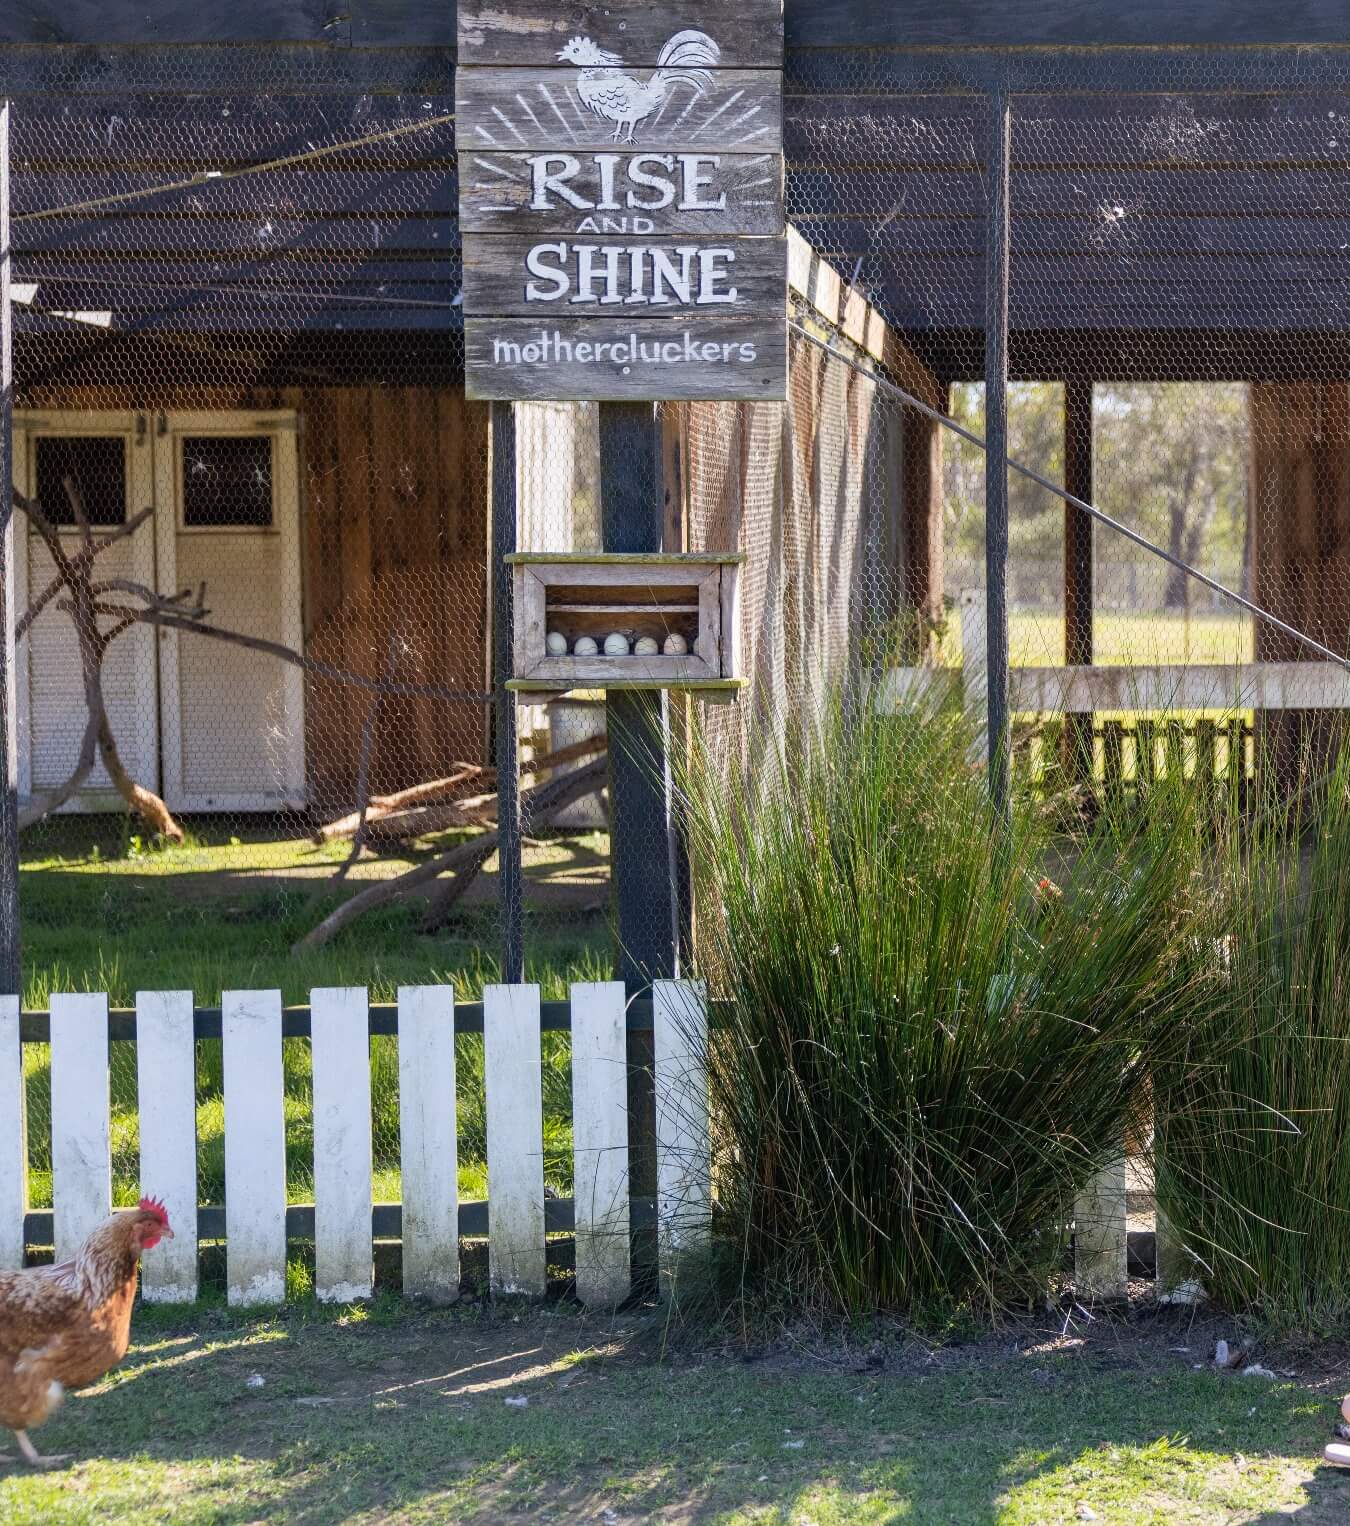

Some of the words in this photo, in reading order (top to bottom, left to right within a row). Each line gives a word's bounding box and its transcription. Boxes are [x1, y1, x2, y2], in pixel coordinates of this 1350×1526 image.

[526, 153, 726, 211] RISE
[575, 216, 655, 234] AND
[525, 241, 738, 305] SHINE
[493, 330, 758, 364] mothercluckers
